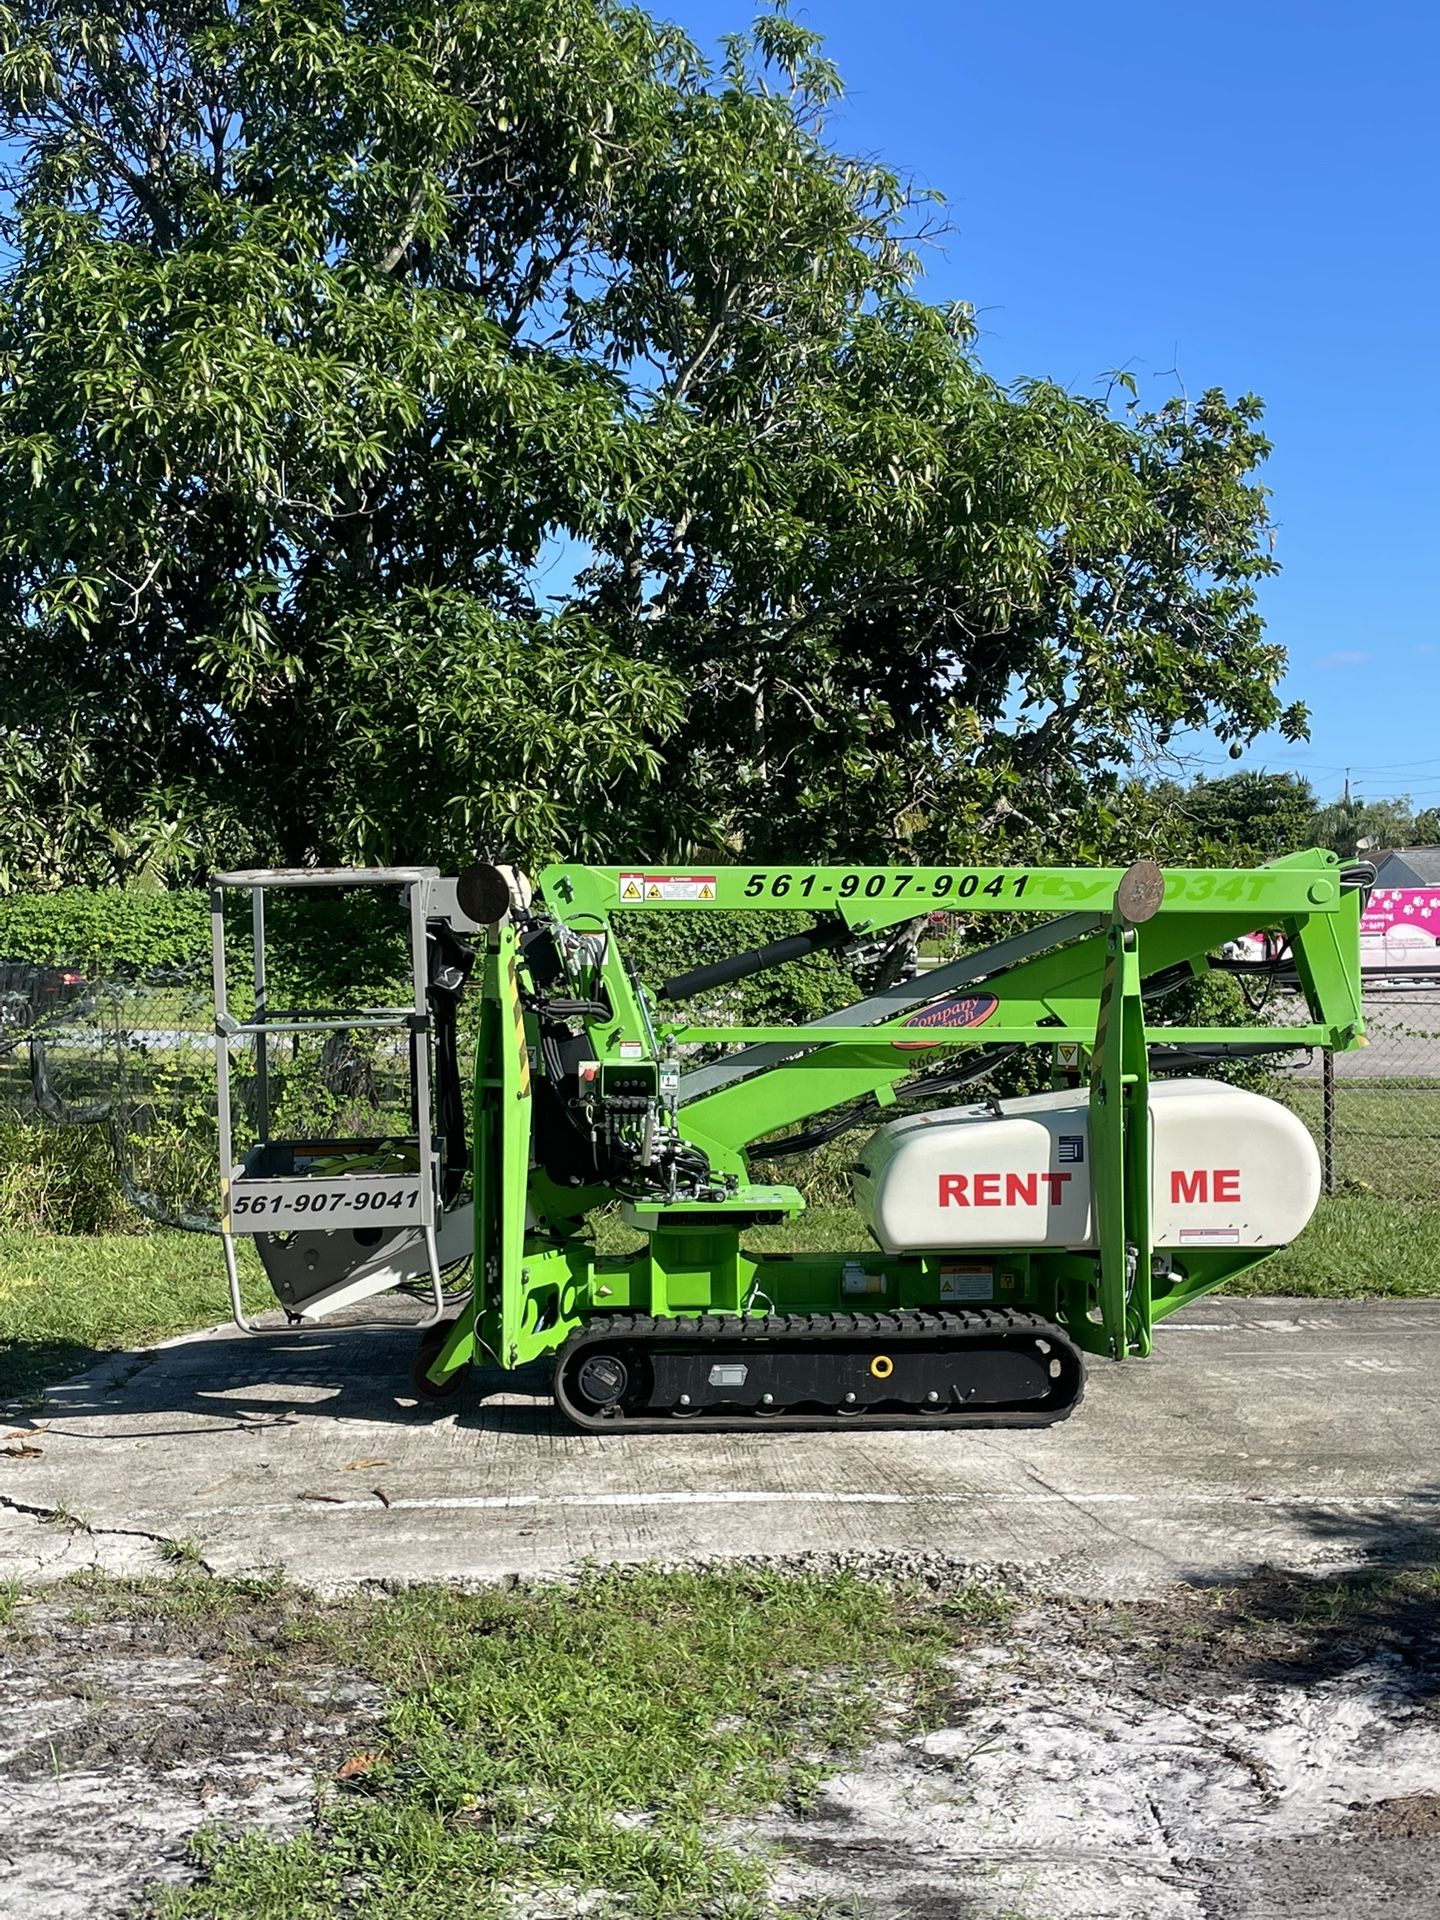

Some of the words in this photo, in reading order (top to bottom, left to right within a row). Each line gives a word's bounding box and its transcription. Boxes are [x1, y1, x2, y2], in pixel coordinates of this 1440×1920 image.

[744, 874, 1030, 898] 561-907-9041
[906, 996, 979, 1028] Company
[232, 1190, 420, 1215] 561-907-9041
[938, 1172, 1072, 1208] RENT
[1170, 1169, 1241, 1204] ME
